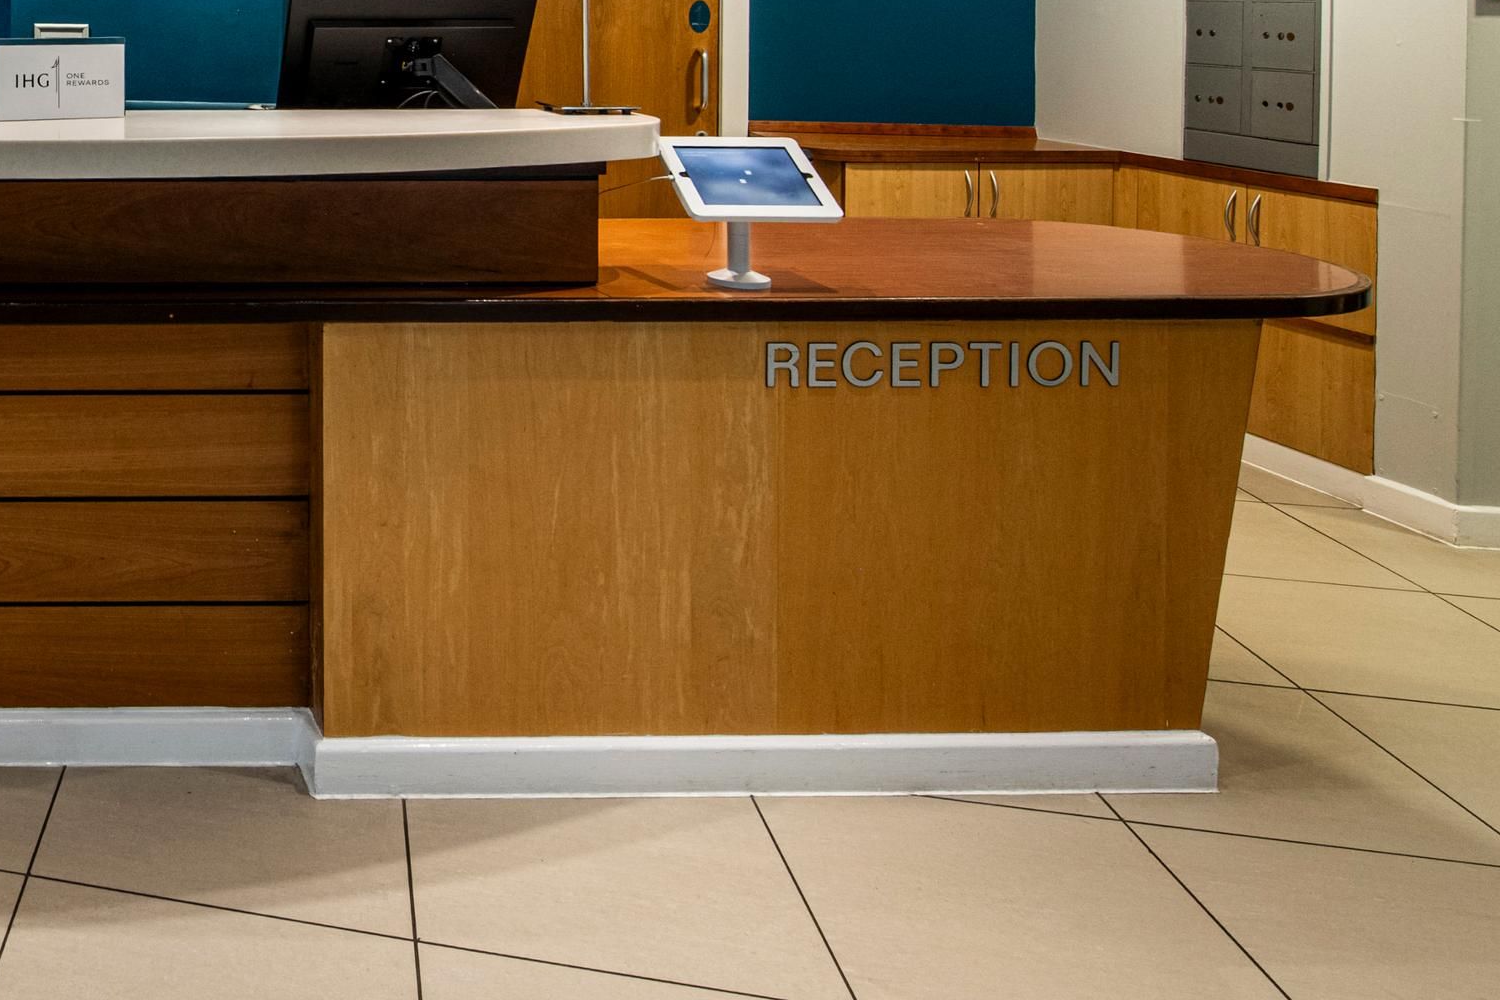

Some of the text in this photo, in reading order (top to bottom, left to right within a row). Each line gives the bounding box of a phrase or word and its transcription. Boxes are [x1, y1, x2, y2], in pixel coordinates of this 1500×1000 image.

[15, 73, 50, 89] IHG
[66, 79, 110, 87] REWARDS
[764, 340, 1121, 388] RECEPTION
